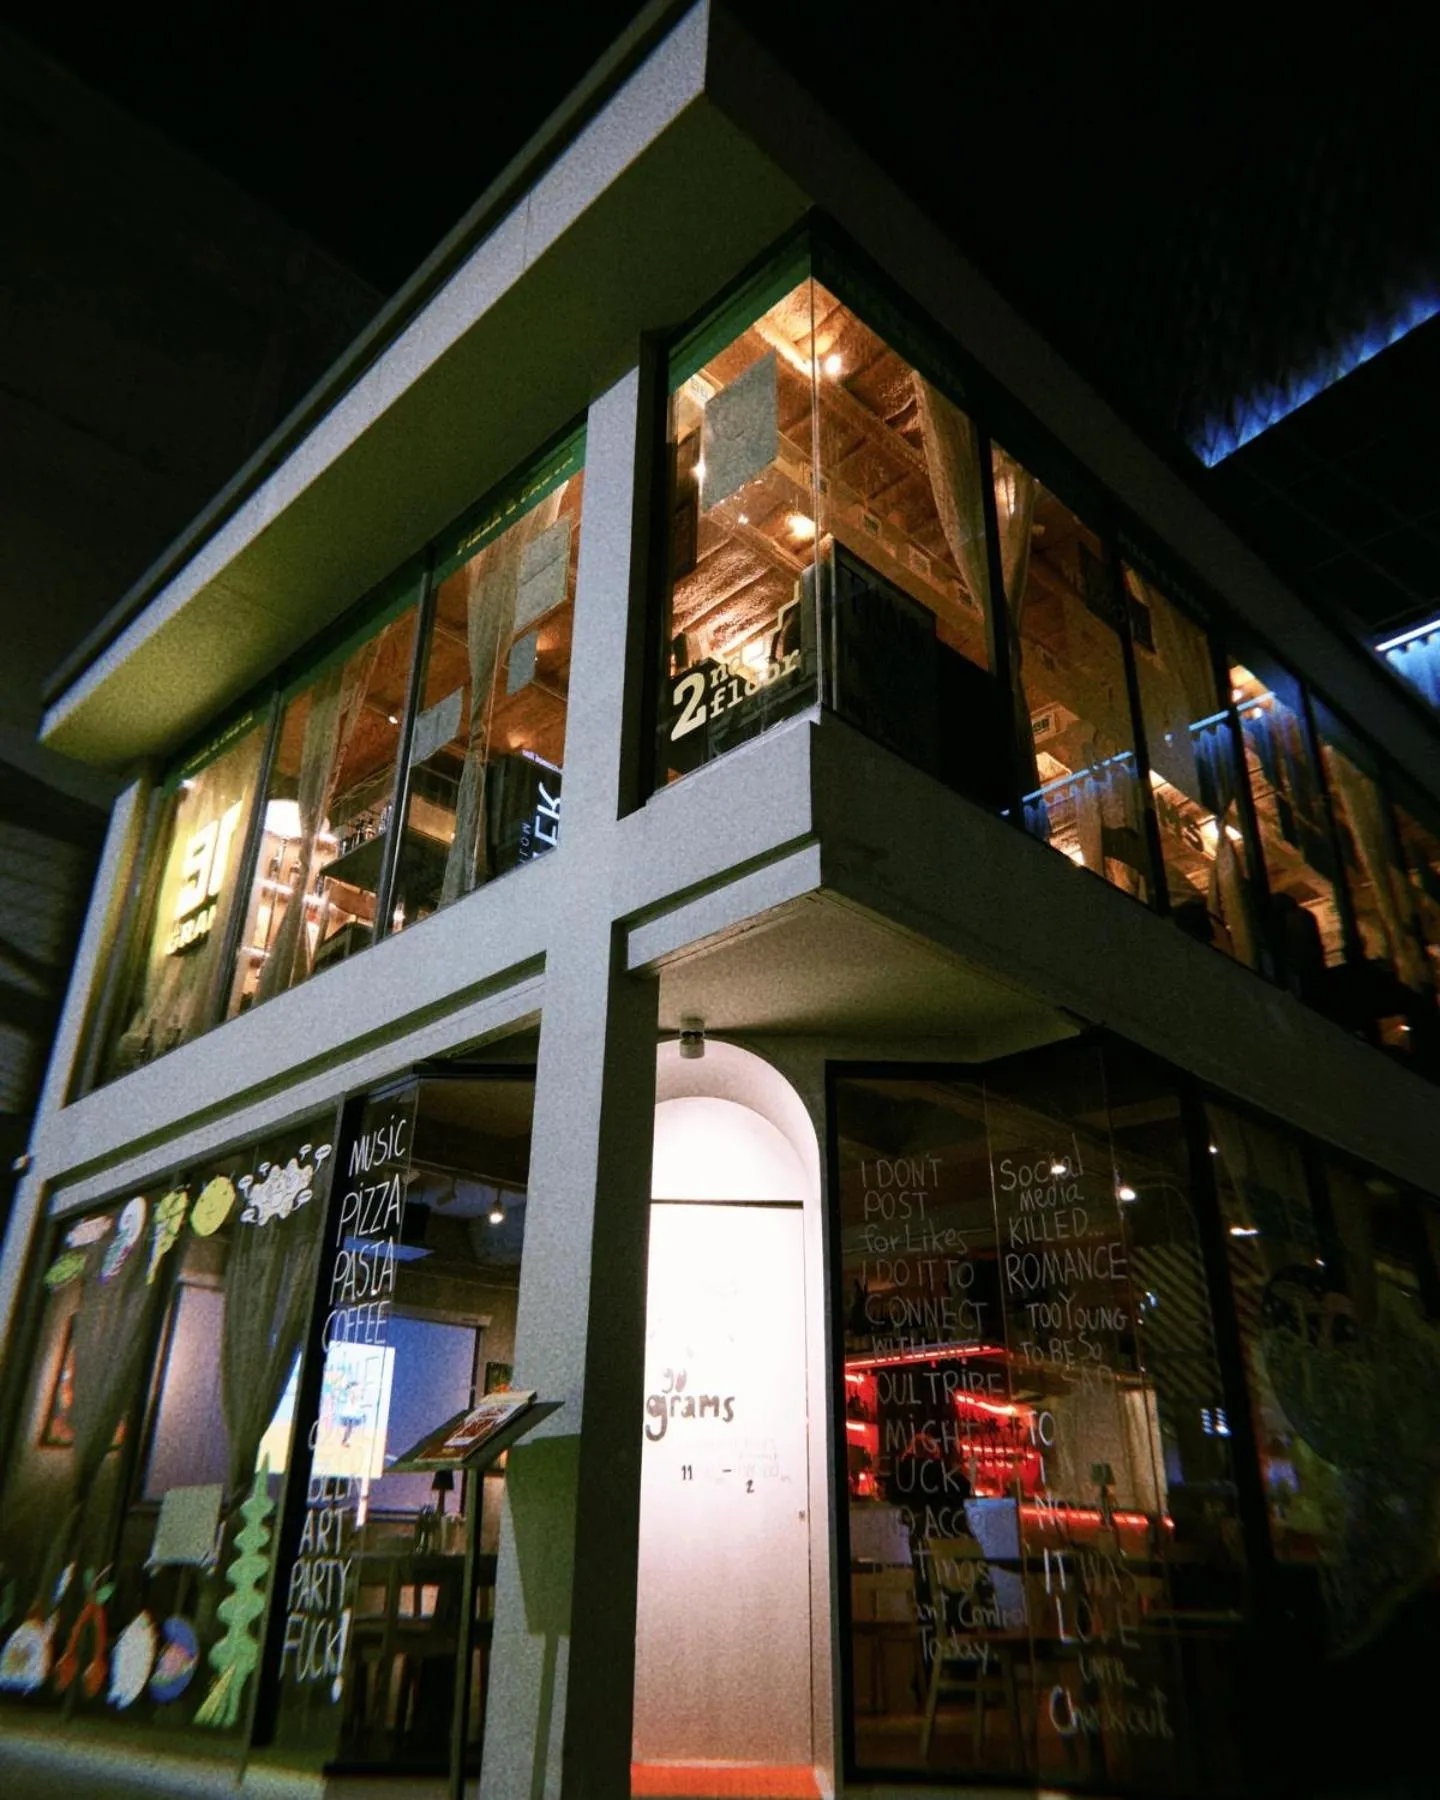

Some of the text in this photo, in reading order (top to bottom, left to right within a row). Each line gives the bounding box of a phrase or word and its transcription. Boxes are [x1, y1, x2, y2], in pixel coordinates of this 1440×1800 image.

[710, 649, 801, 718] floor
[863, 1190, 929, 1222] POST
[1020, 1180, 1085, 1213] media
[328, 1236, 395, 1307] PASTA
[875, 1260, 911, 1288] DO
[945, 1258, 975, 1291] TO
[1004, 1241, 1129, 1295] ROMANCE
[321, 1299, 392, 1353] COFFEE
[864, 1295, 989, 1334] CONNECT
[1020, 1340, 1045, 1367] TO
[1049, 1336, 1077, 1368] BE
[645, 1393, 736, 1442] grams
[298, 1505, 352, 1557] ART
[286, 1556, 353, 1613] PARTY
